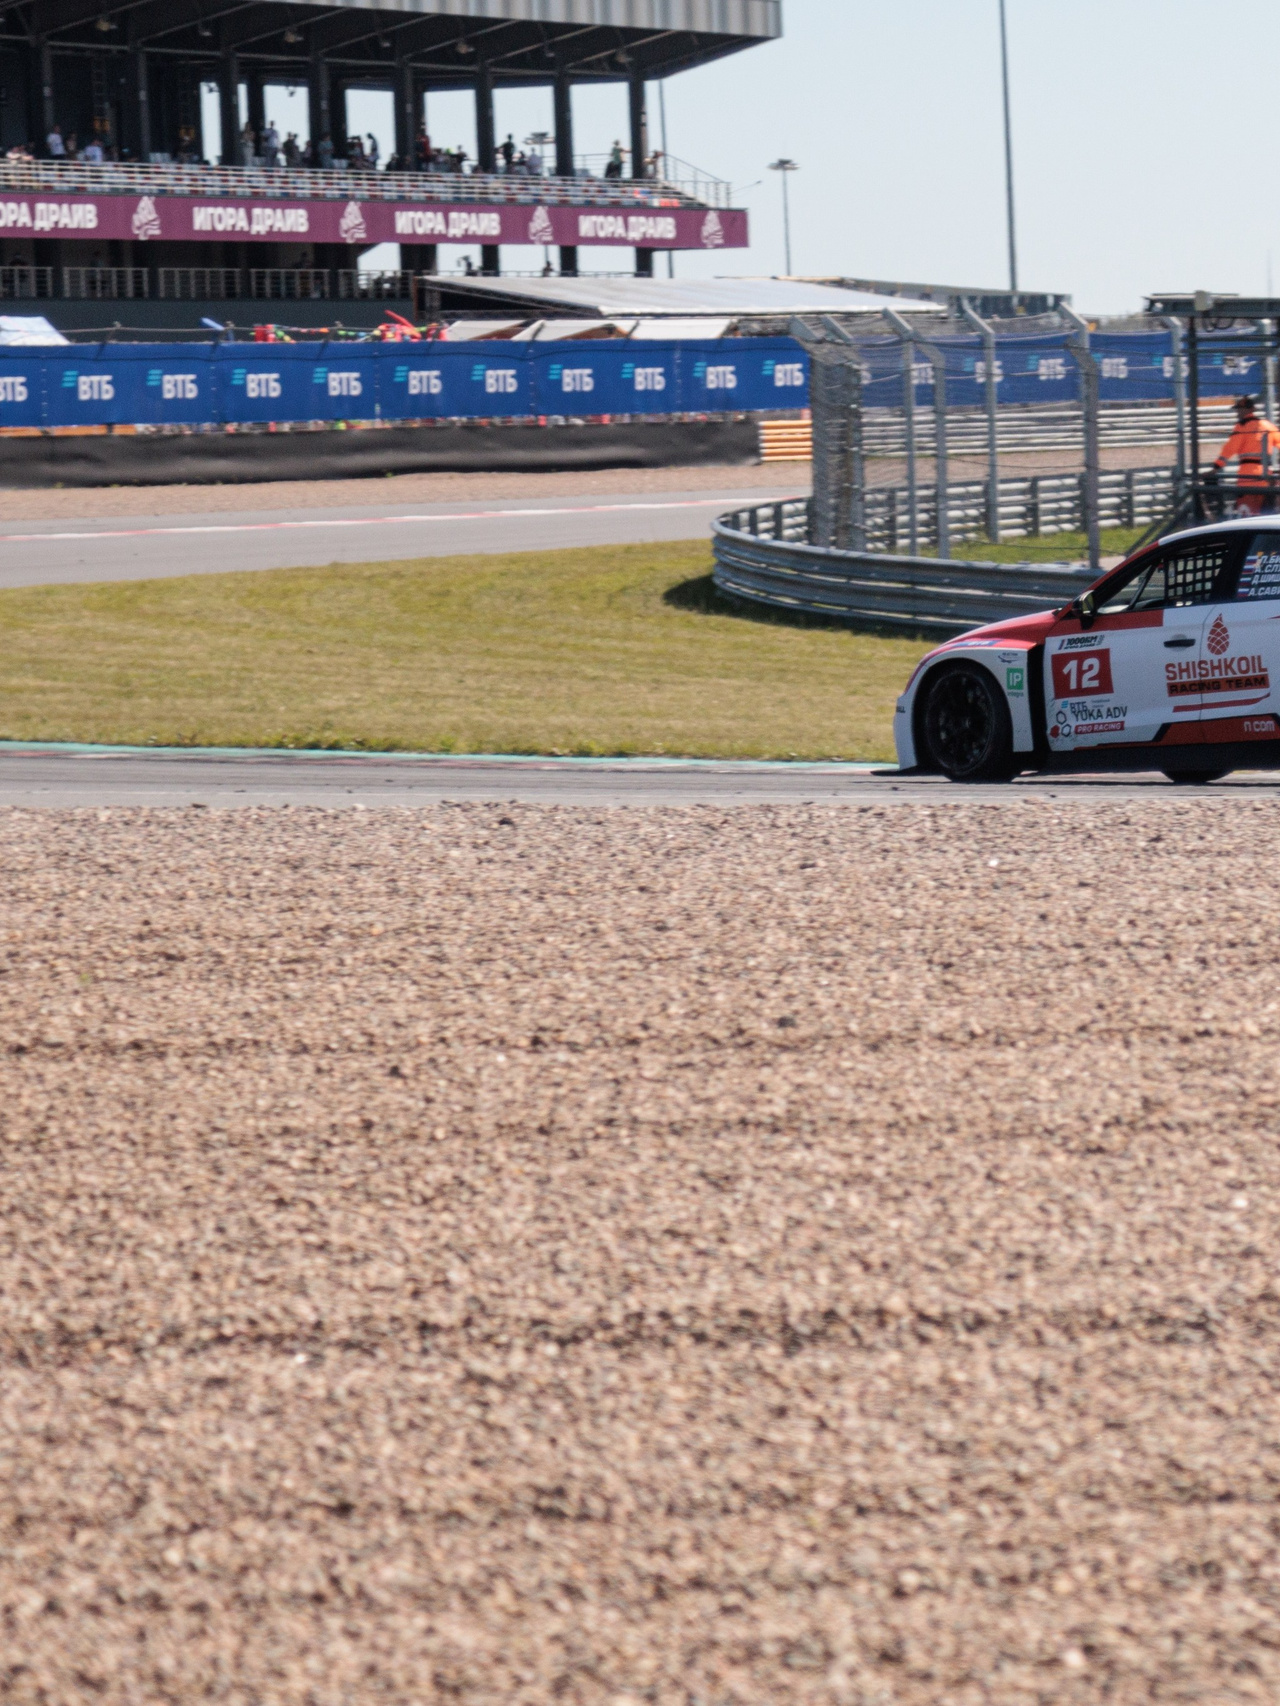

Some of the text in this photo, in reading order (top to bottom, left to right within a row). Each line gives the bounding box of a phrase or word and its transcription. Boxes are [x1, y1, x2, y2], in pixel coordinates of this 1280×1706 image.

[193, 206, 249, 231] ИГОРА
[395, 211, 447, 235] ИГОРА
[579, 215, 627, 238] ИГОРА
[162, 374, 198, 399] ВТБ
[246, 373, 281, 397] ВТБ
[328, 372, 362, 396] ВТБ
[408, 370, 442, 394] ВТБ
[485, 369, 518, 393] ВТБ
[562, 368, 594, 392] ВТБ
[634, 367, 665, 391] ВТБ
[706, 366, 737, 389] ВТБ
[774, 363, 804, 387] ВТБ
[78, 375, 114, 400] ВТБ
[1010, 672, 1022, 688] IP
[1062, 657, 1100, 690] 12
[1165, 655, 1268, 681] SHISHKOIL
[1169, 677, 1266, 694] RACING TEAM
[1105, 706, 1128, 719] ADV
[1077, 722, 1121, 733] PRO RACING
